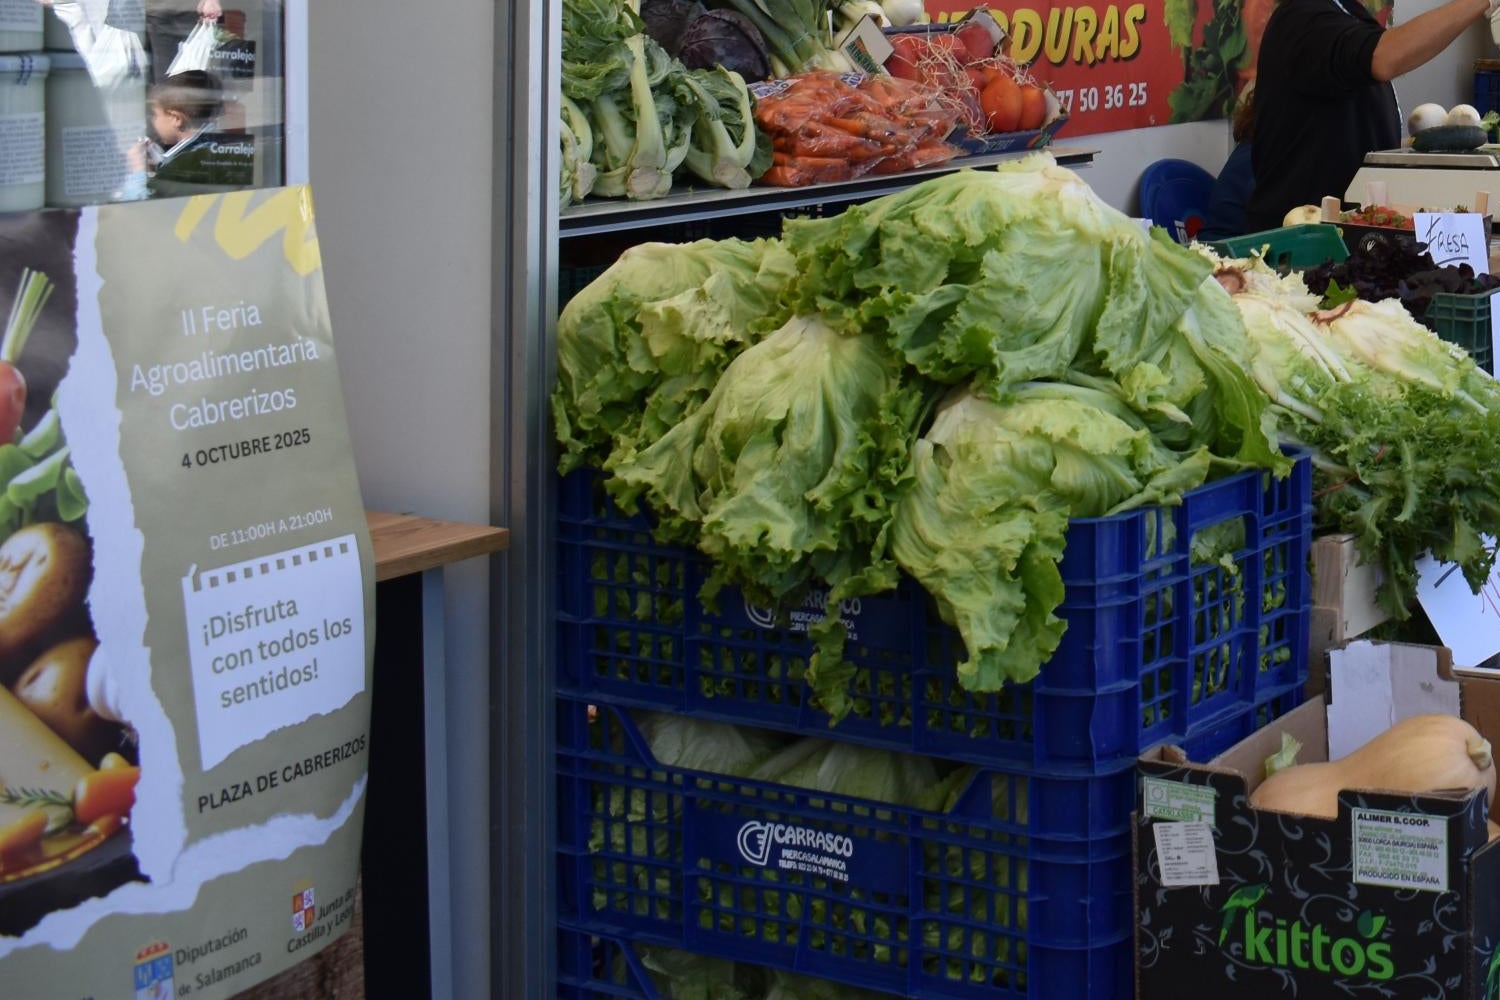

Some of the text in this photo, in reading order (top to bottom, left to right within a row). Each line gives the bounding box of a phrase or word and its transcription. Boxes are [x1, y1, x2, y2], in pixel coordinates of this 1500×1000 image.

[1080, 86, 1099, 113] 50
[1104, 84, 1124, 109] 36
[1128, 82, 1148, 107] 25
[1425, 215, 1469, 253] FRESA
[181, 300, 262, 336] II Feria
[131, 335, 320, 396] Agroalimentaria
[170, 388, 297, 431] Cabrerizos
[181, 428, 312, 469] 4 OCTUBRE 2025
[210, 507, 333, 550] DE 11:00H A 21:00H
[203, 598, 299, 647] ¡Disfruta
[211, 616, 353, 675] con todos los
[220, 658, 319, 709] sentidos!
[197, 734, 367, 813] PLAZA DE CABRERIZOS
[1357, 813, 1392, 824] ALIMER
[774, 823, 853, 857] CARRASCO
[317, 894, 348, 922] Junta
[176, 927, 249, 967] Diputación
[287, 918, 326, 954] Castilla
[1245, 910, 1395, 981] kittos
[178, 951, 263, 998] de Salamanca
